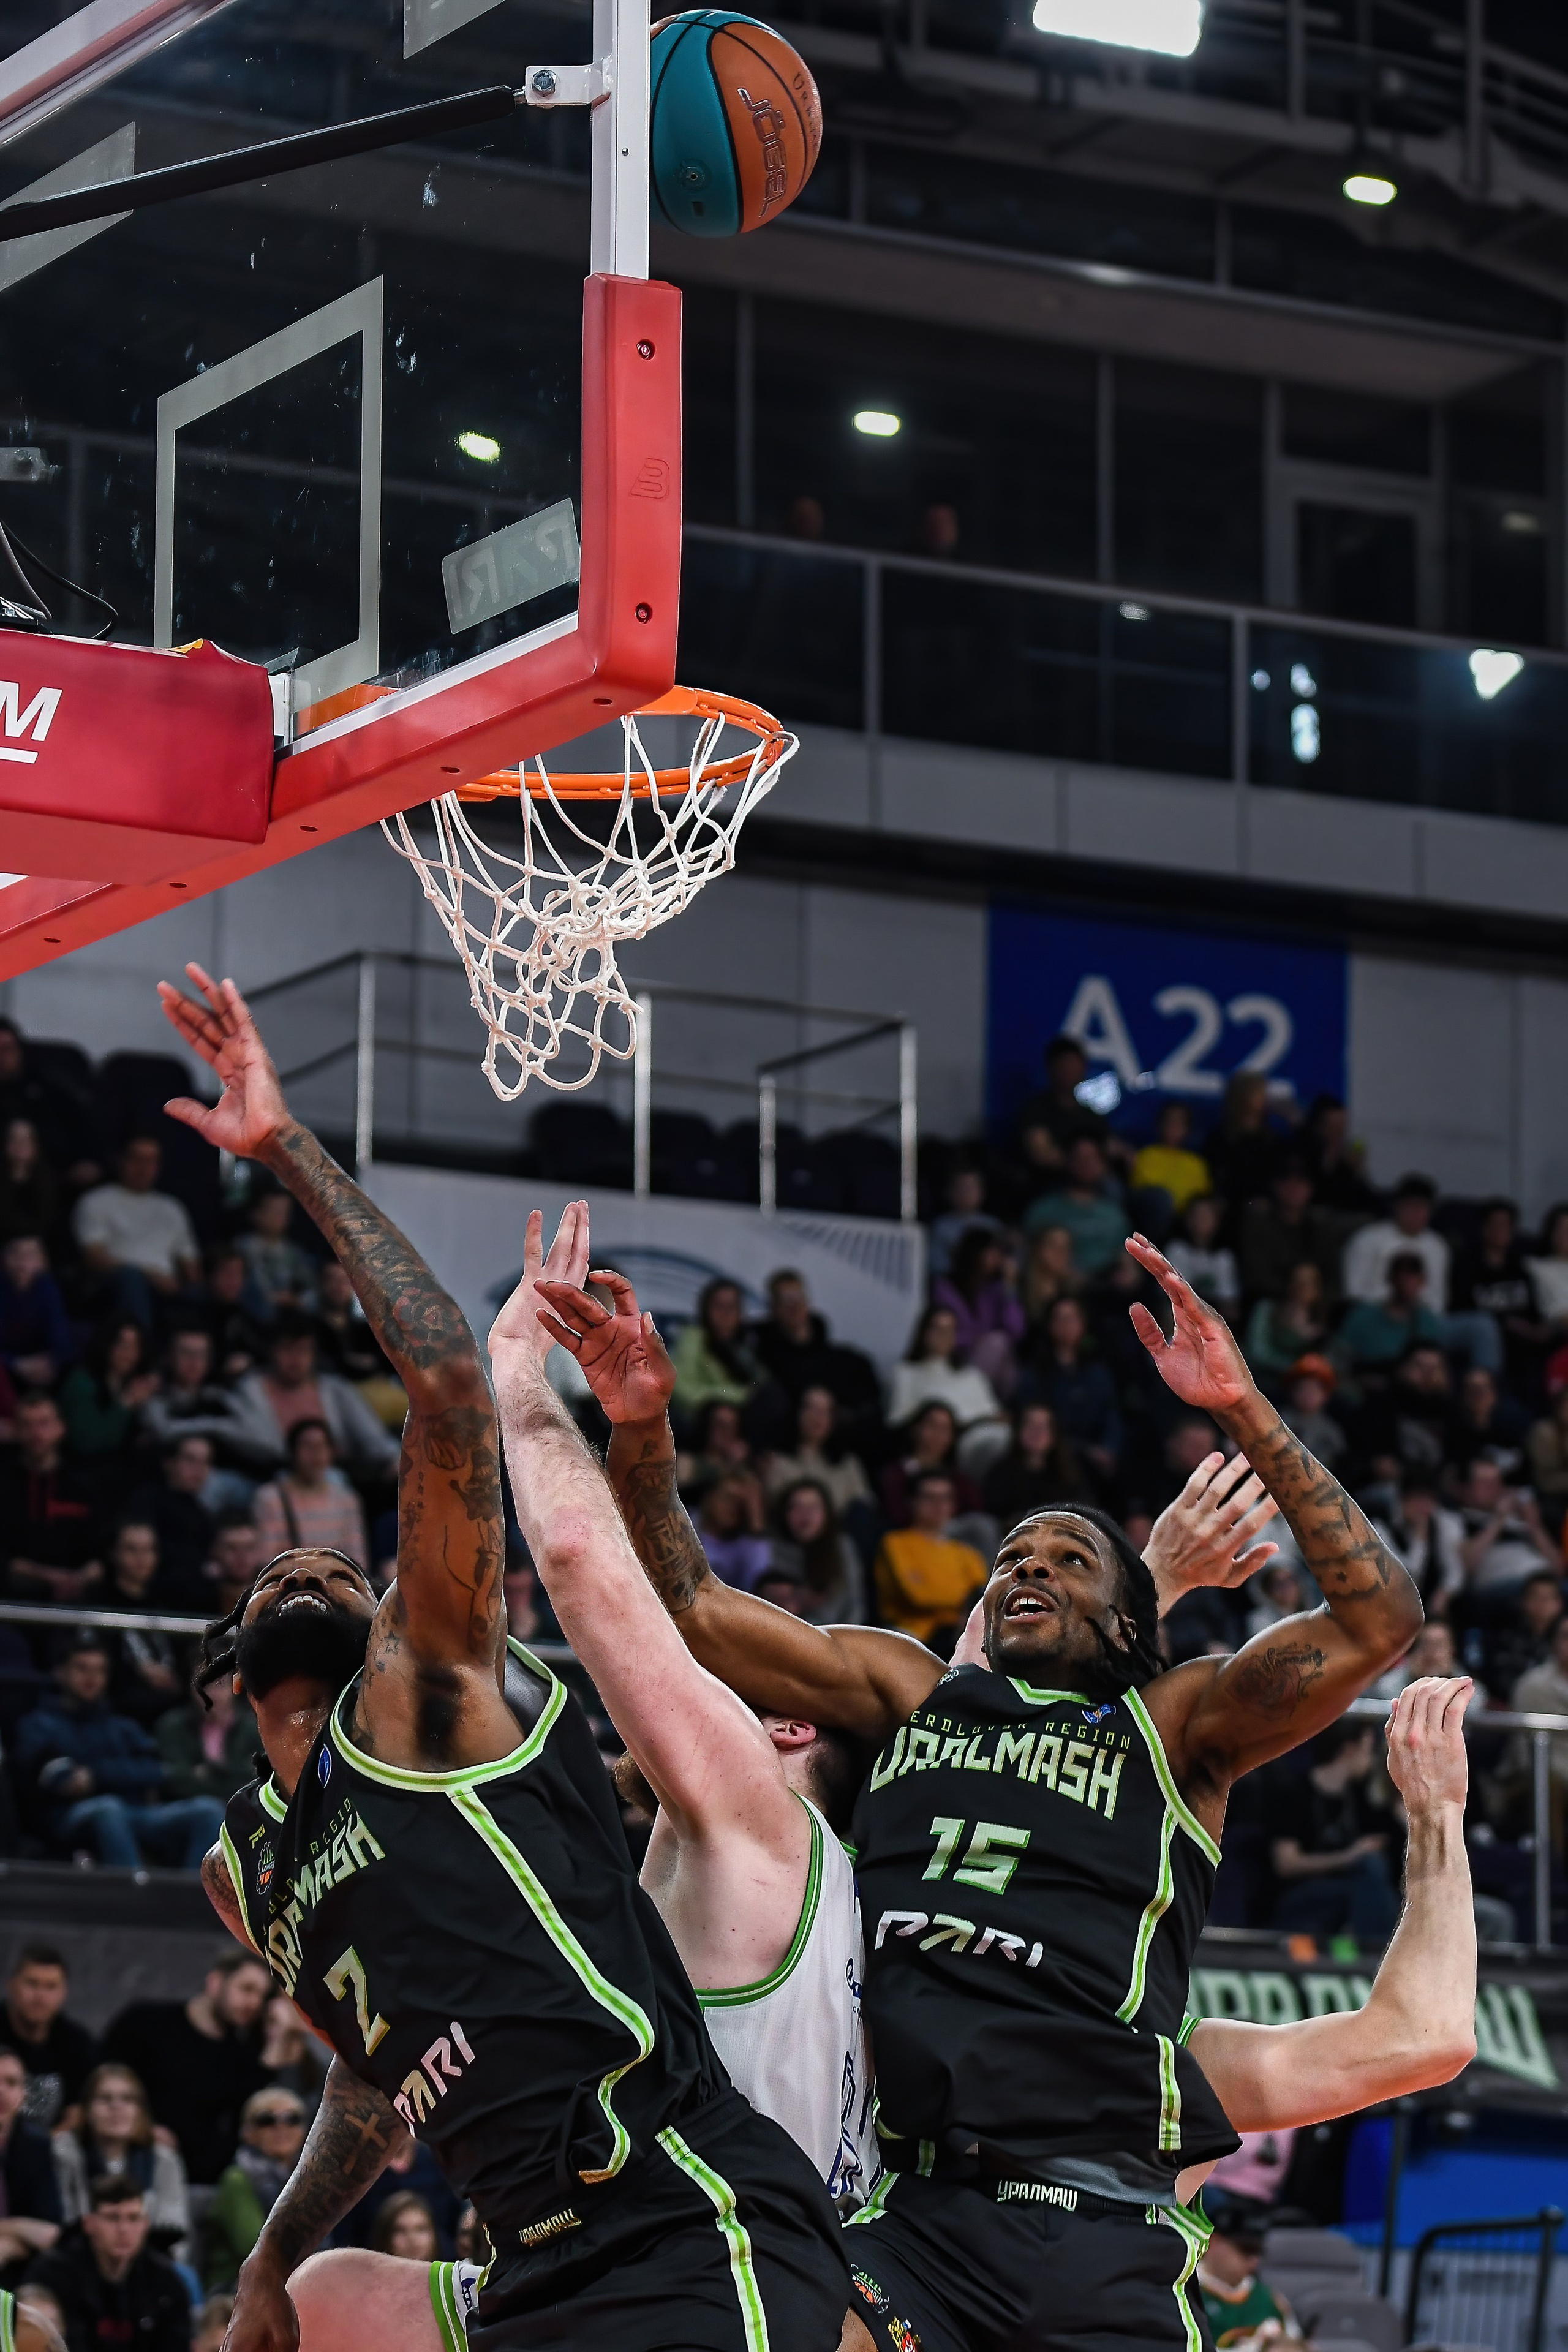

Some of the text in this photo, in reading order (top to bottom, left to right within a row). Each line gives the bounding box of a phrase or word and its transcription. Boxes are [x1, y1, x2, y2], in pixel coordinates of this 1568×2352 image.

[737, 87, 787, 218] JÖGEL
[1058, 974, 1295, 1095] A22
[870, 1726, 1126, 1820] URALMASH
[1046, 1722, 1131, 1750] REGION
[922, 1815, 1031, 1895] 15
[875, 1910, 1044, 1968] PARI
[393, 2021, 475, 2139] PARI
[997, 2180, 1078, 2212] УРАЛМАШ
